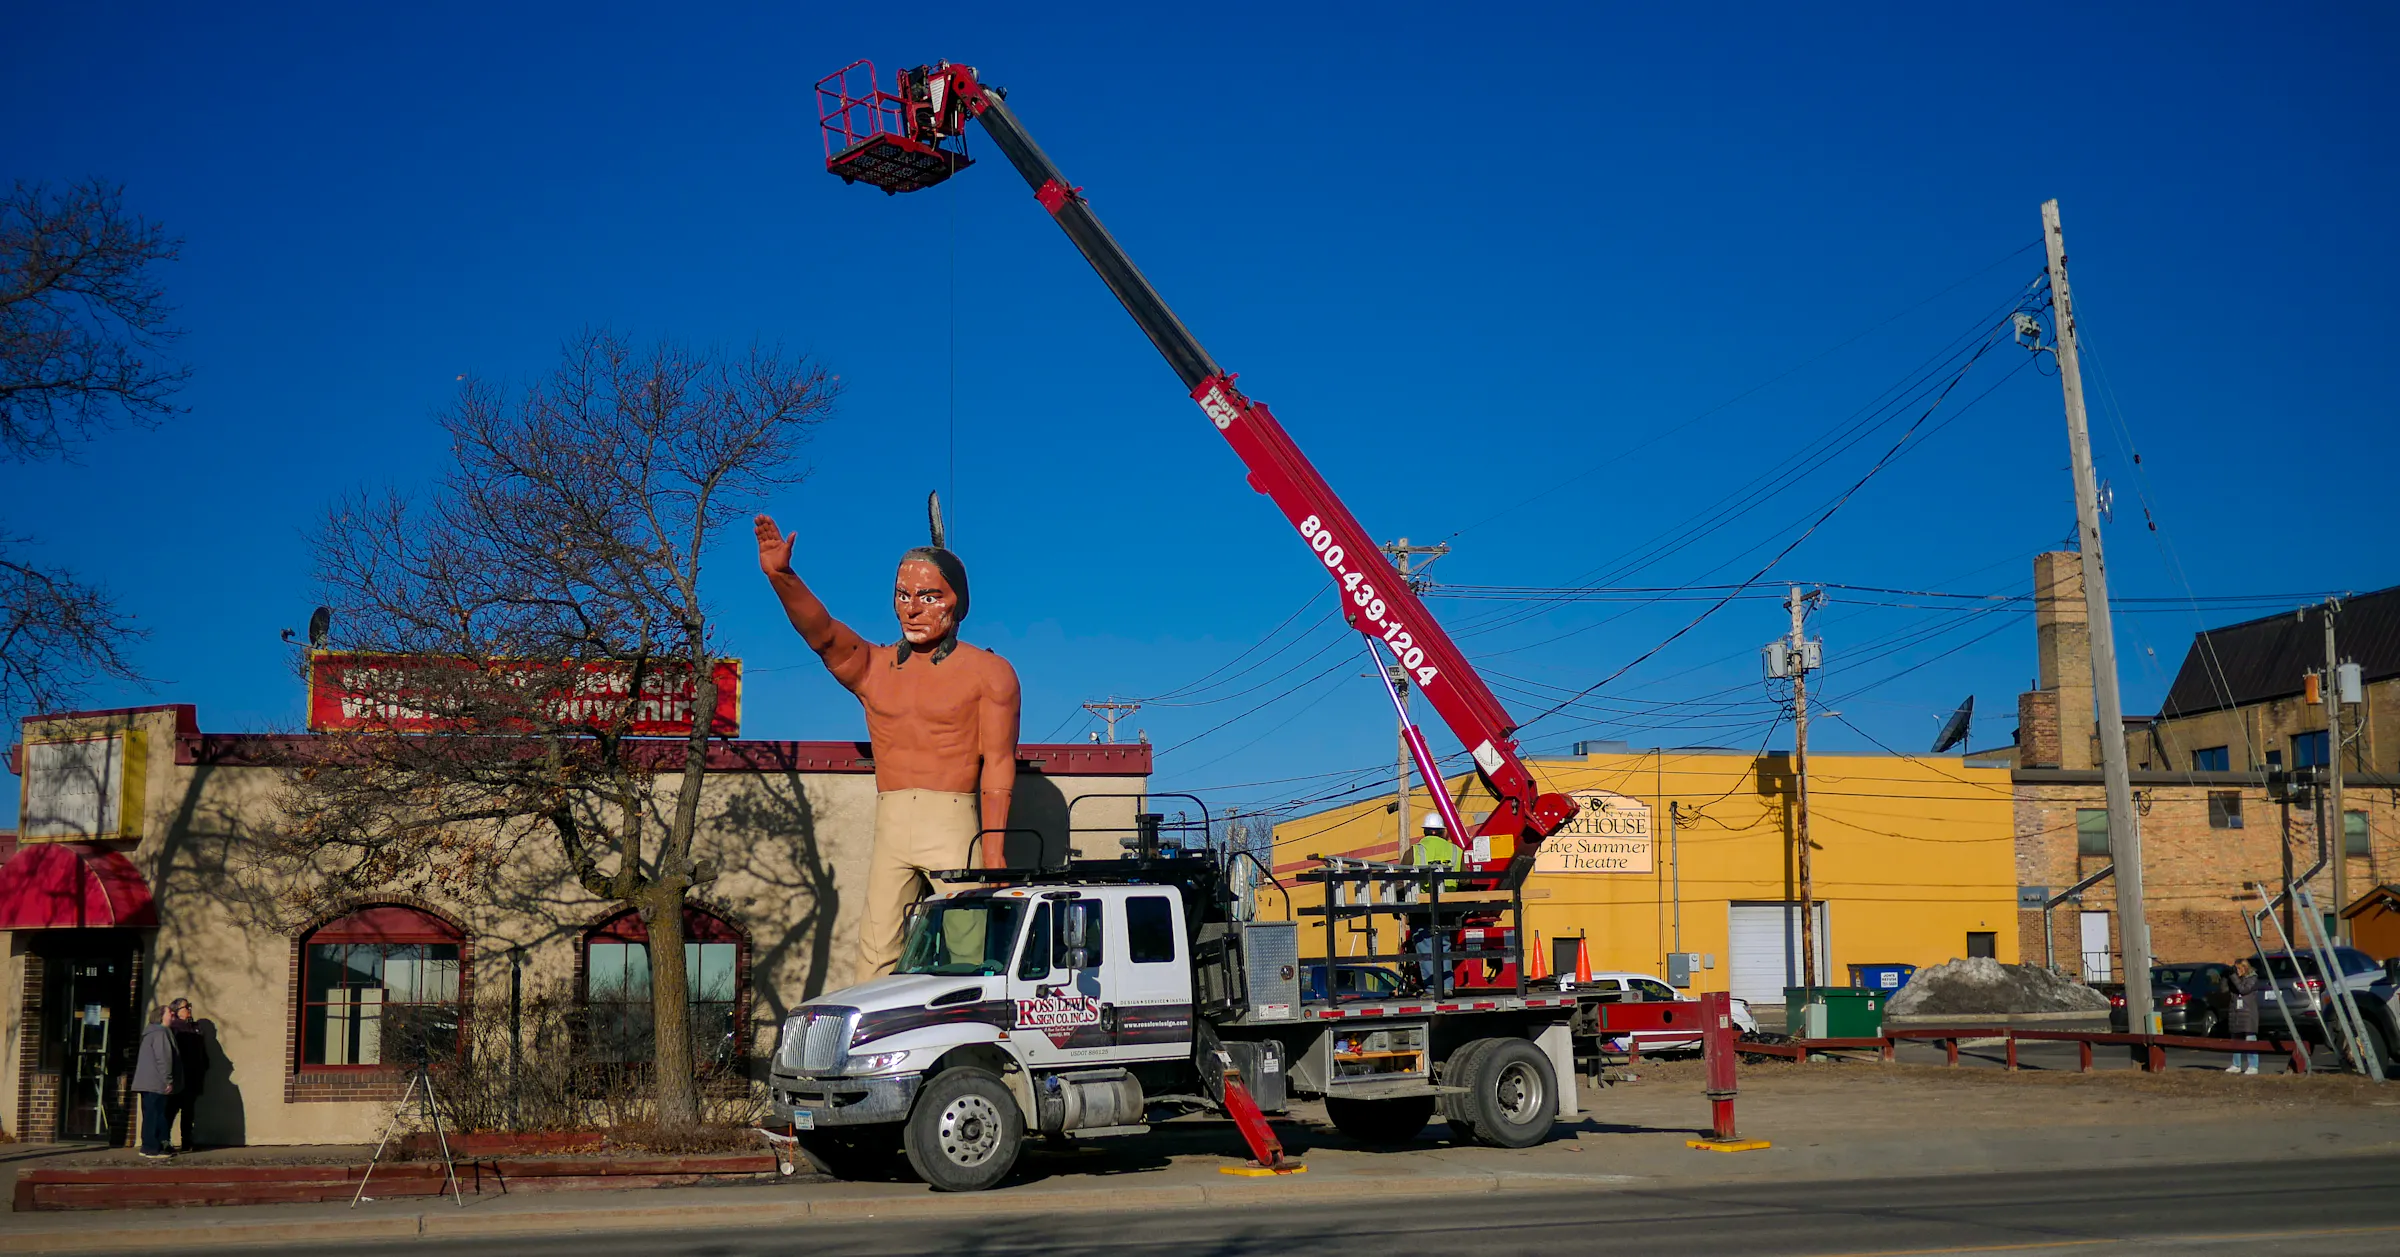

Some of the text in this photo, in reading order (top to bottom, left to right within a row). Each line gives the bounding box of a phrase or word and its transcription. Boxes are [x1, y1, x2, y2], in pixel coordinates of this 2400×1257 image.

[1199, 394, 1230, 429] L60
[1209, 386, 1239, 421] ELLIOTT
[1300, 514, 1439, 688] 800-439-1204
[573, 667, 698, 697] jewelr
[527, 692, 698, 722] ouvenir
[1538, 840, 1649, 854] Live Summer
[1560, 854, 1628, 869] Theatre
[1017, 996, 1099, 1025] ROSS LEWIS
[1036, 1014, 1055, 1025] SIGN
[1124, 1020, 1188, 1029] www.rosslewissign.com
